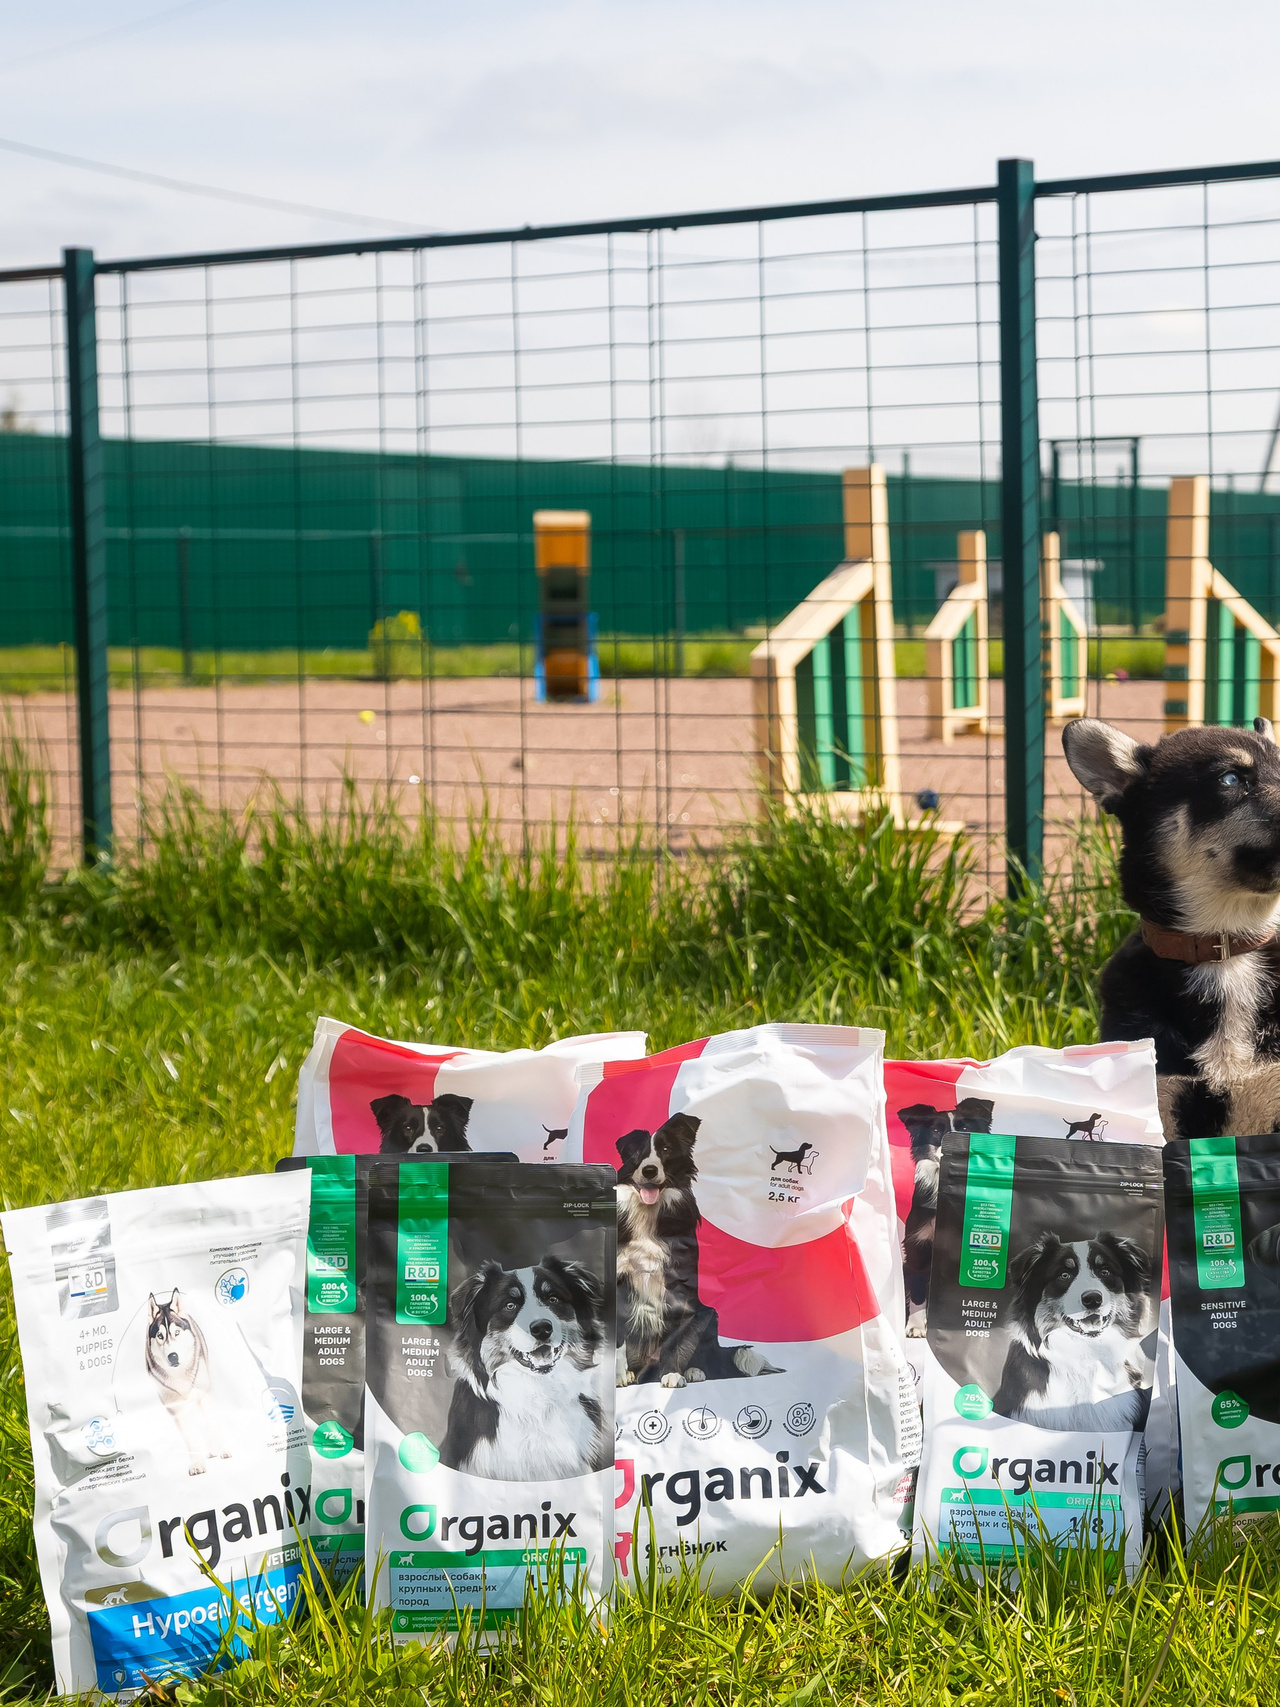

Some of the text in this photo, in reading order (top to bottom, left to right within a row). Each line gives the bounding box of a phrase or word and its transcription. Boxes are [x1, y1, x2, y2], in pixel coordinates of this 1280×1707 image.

[768, 1191, 800, 1204] 2,5 кг
[972, 1233, 1000, 1245] R&D
[1205, 1233, 1233, 1245] R&D
[408, 1267, 437, 1278] R&D
[962, 1300, 998, 1309] LARGE &
[1201, 1301, 1246, 1310] SENSITIVE
[961, 1309, 997, 1319] MEDIUM
[1210, 1311, 1238, 1320] ADULT
[964, 1320, 993, 1328] ADULT
[1213, 1321, 1237, 1329] DOGS
[79, 1325, 109, 1340] 4+ MO.
[314, 1326, 351, 1335] LARGE &
[965, 1329, 991, 1338] DOGS
[314, 1336, 351, 1345] MEDIUM
[401, 1337, 440, 1347] LARGE &
[76, 1338, 114, 1356] PUPPIES
[318, 1347, 347, 1356] ADULT
[402, 1347, 440, 1357] MEDIUM
[79, 1354, 113, 1371] & DOGS
[319, 1358, 345, 1366] DOGS
[405, 1358, 435, 1367] ADULT
[407, 1369, 433, 1378] DOGS
[964, 1393, 984, 1402] 76%
[1220, 1400, 1240, 1409] 65%
[323, 1431, 344, 1440] 72%
[952, 1445, 1119, 1495] Organix
[950, 1508, 997, 1517] взрослые
[95, 1472, 311, 1575] Organix
[400, 1501, 578, 1556] Organix
[398, 1572, 446, 1582] взрослые
[398, 1585, 442, 1595] крупных
[454, 1584, 497, 1593] средних
[398, 1597, 430, 1606] пород
